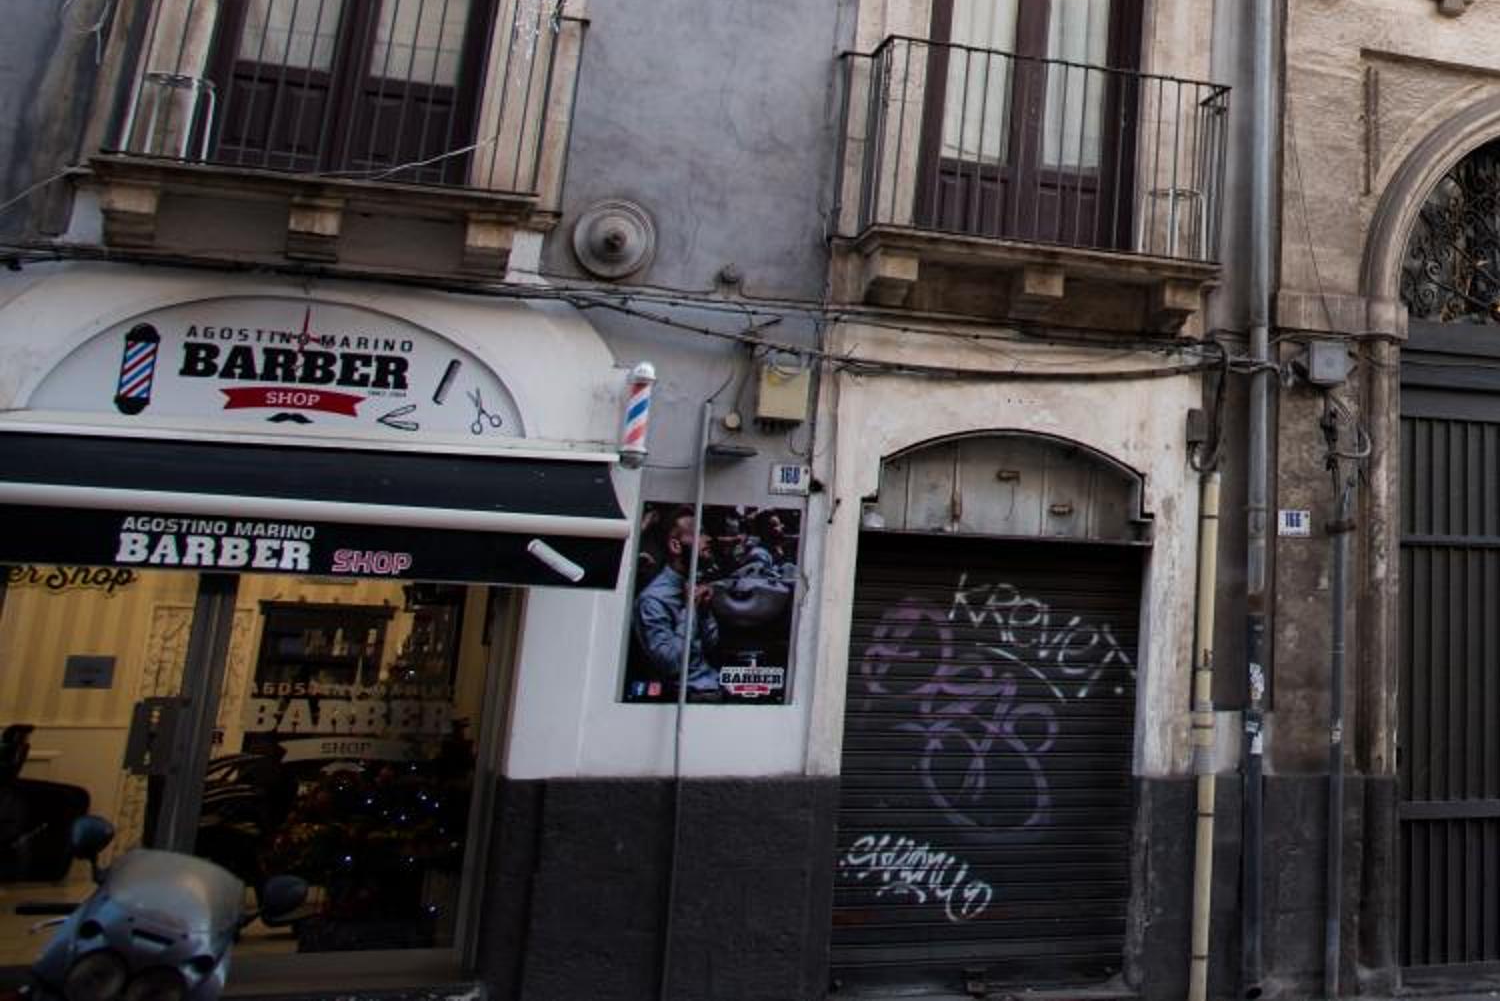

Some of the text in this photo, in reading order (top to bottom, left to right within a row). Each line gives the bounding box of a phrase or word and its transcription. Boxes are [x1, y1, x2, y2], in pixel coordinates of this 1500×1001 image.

[185, 325, 414, 353] AGOSTINO MARINO
[178, 341, 409, 389] BARBER
[264, 391, 321, 407] SHOP
[122, 516, 316, 541] AGOSTINO MARINO
[115, 532, 413, 575] BARBER SHOP
[246, 697, 455, 734] BARBER
[320, 742, 372, 755] SHOP
